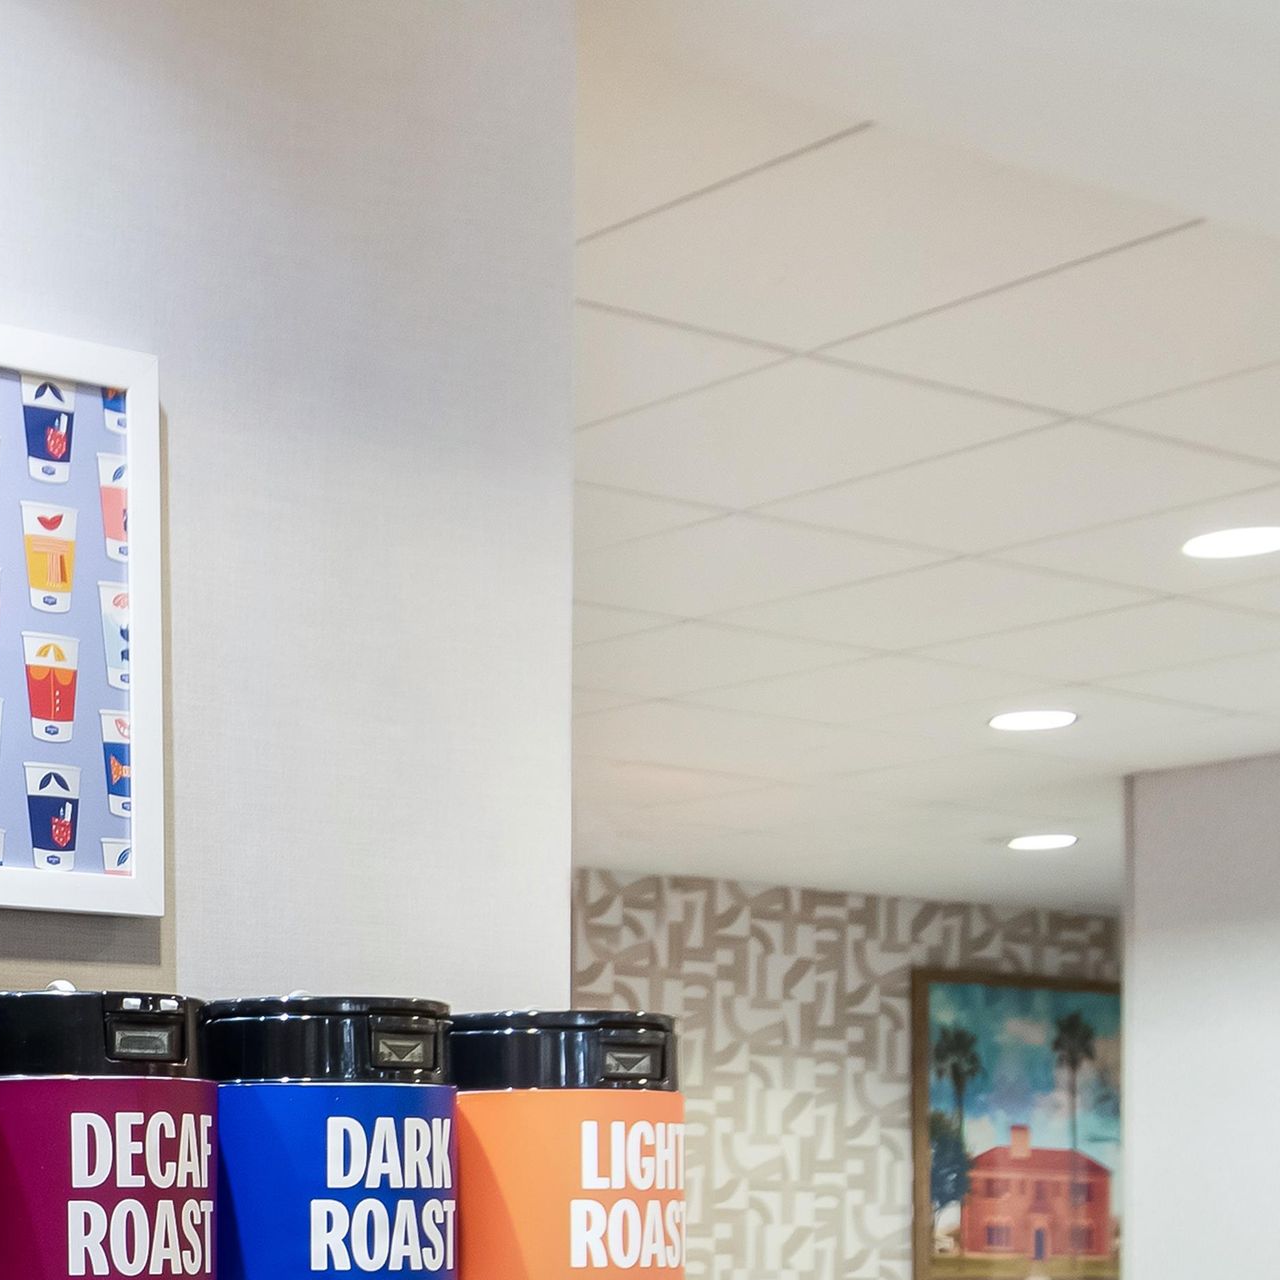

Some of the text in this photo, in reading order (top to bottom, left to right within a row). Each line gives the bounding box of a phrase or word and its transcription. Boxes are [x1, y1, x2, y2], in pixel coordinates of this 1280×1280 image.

[69, 1110, 213, 1189] DECAF
[325, 1115, 453, 1190] DARK
[579, 1119, 686, 1191] LIGHT
[67, 1198, 214, 1277] ROAST
[309, 1197, 457, 1272] ROAST
[569, 1198, 687, 1270] ROAST
